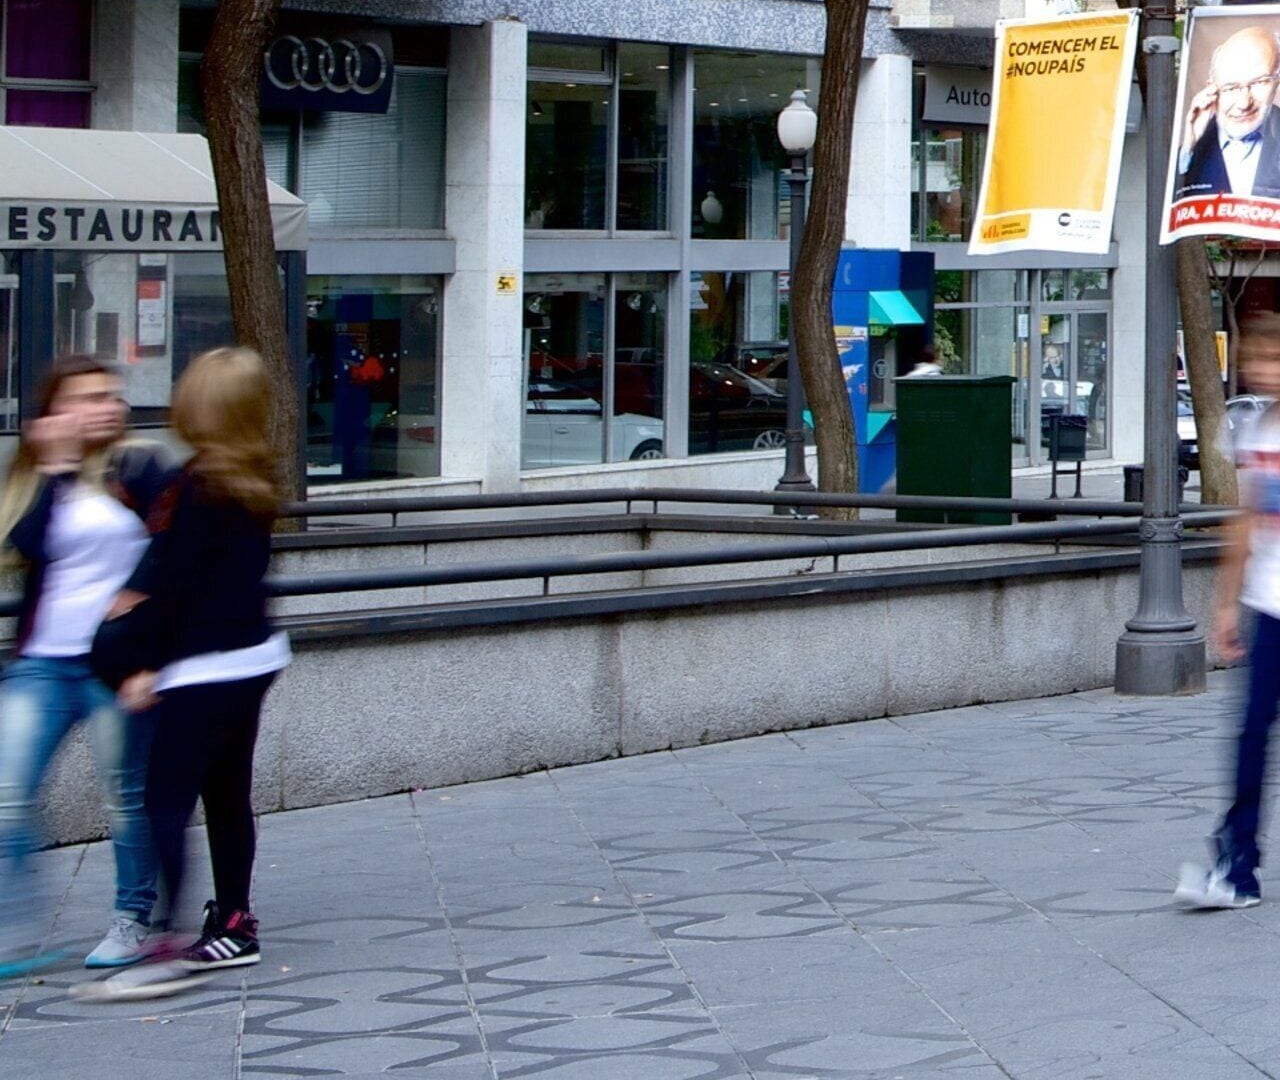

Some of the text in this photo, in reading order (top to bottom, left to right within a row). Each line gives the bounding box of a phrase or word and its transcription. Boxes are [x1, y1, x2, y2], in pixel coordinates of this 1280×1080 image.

[1008, 35, 1119, 57] COMENCEM EL
[1006, 54, 1086, 79] #NOUPAÍS
